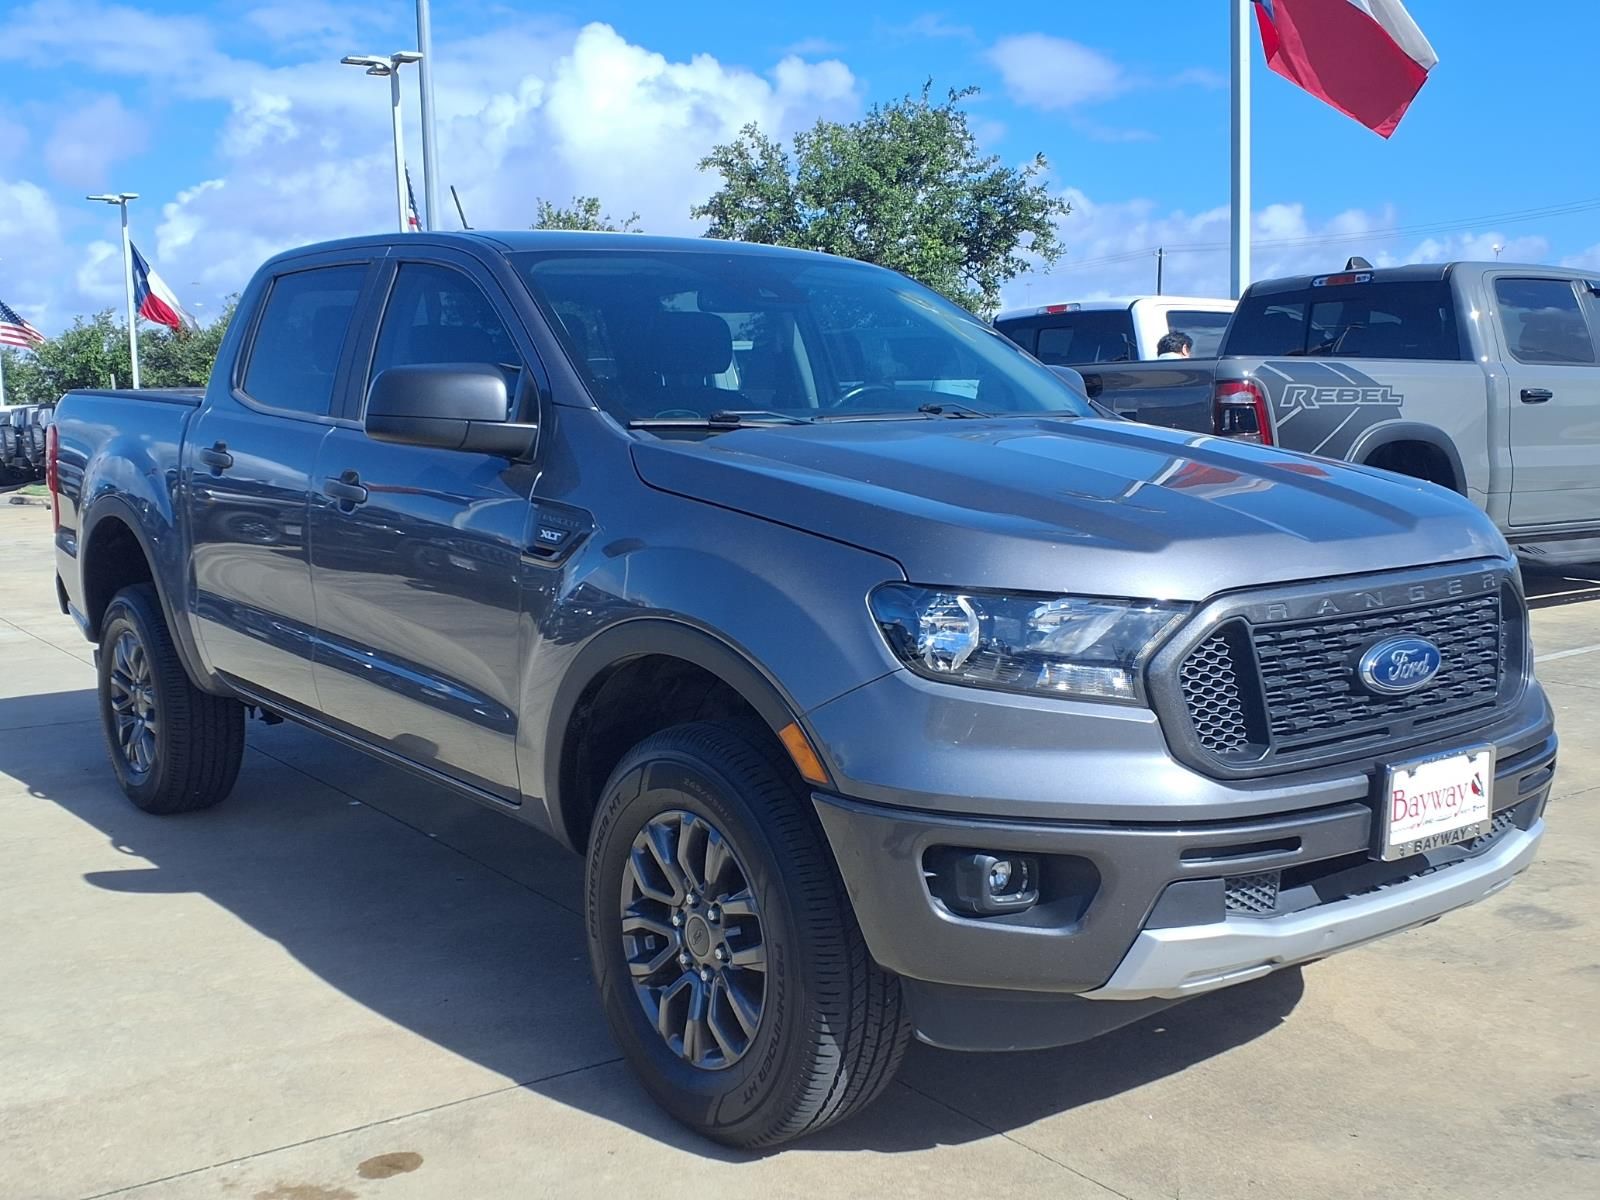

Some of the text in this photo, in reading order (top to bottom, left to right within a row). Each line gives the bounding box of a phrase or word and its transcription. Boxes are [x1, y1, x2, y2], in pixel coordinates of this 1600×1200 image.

[1280, 384, 1403, 409] REBEL
[540, 529, 562, 541] XLT
[1267, 574, 1496, 620] RANGER
[1389, 648, 1430, 681] Ford
[1391, 782, 1469, 828] Bayway
[1414, 827, 1468, 853] BAYWAY
